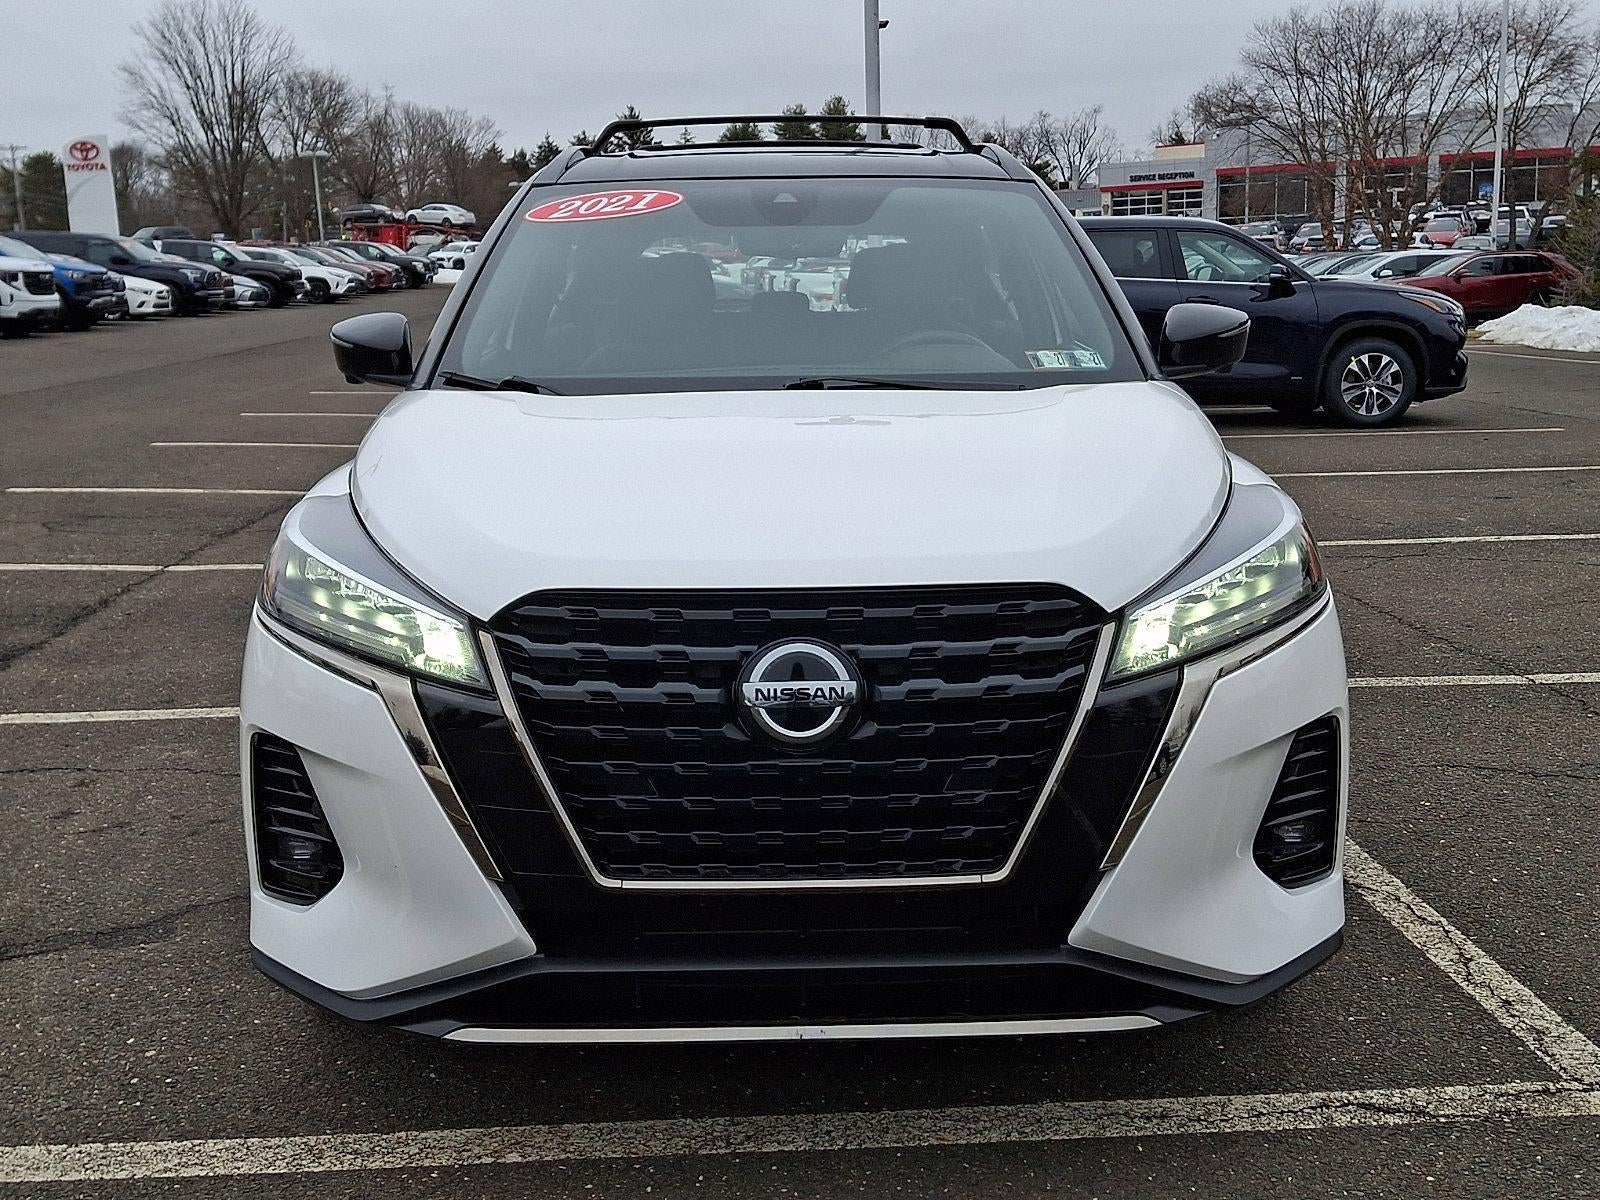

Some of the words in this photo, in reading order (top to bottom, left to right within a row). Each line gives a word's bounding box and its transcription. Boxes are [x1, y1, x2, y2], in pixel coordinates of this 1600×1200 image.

[67, 163, 106, 171] TOYOTA
[1129, 174, 1156, 183] SERVICE
[1158, 171, 1195, 181] RECEPTION
[547, 193, 659, 219] 2021
[754, 687, 845, 701] NISSAN
